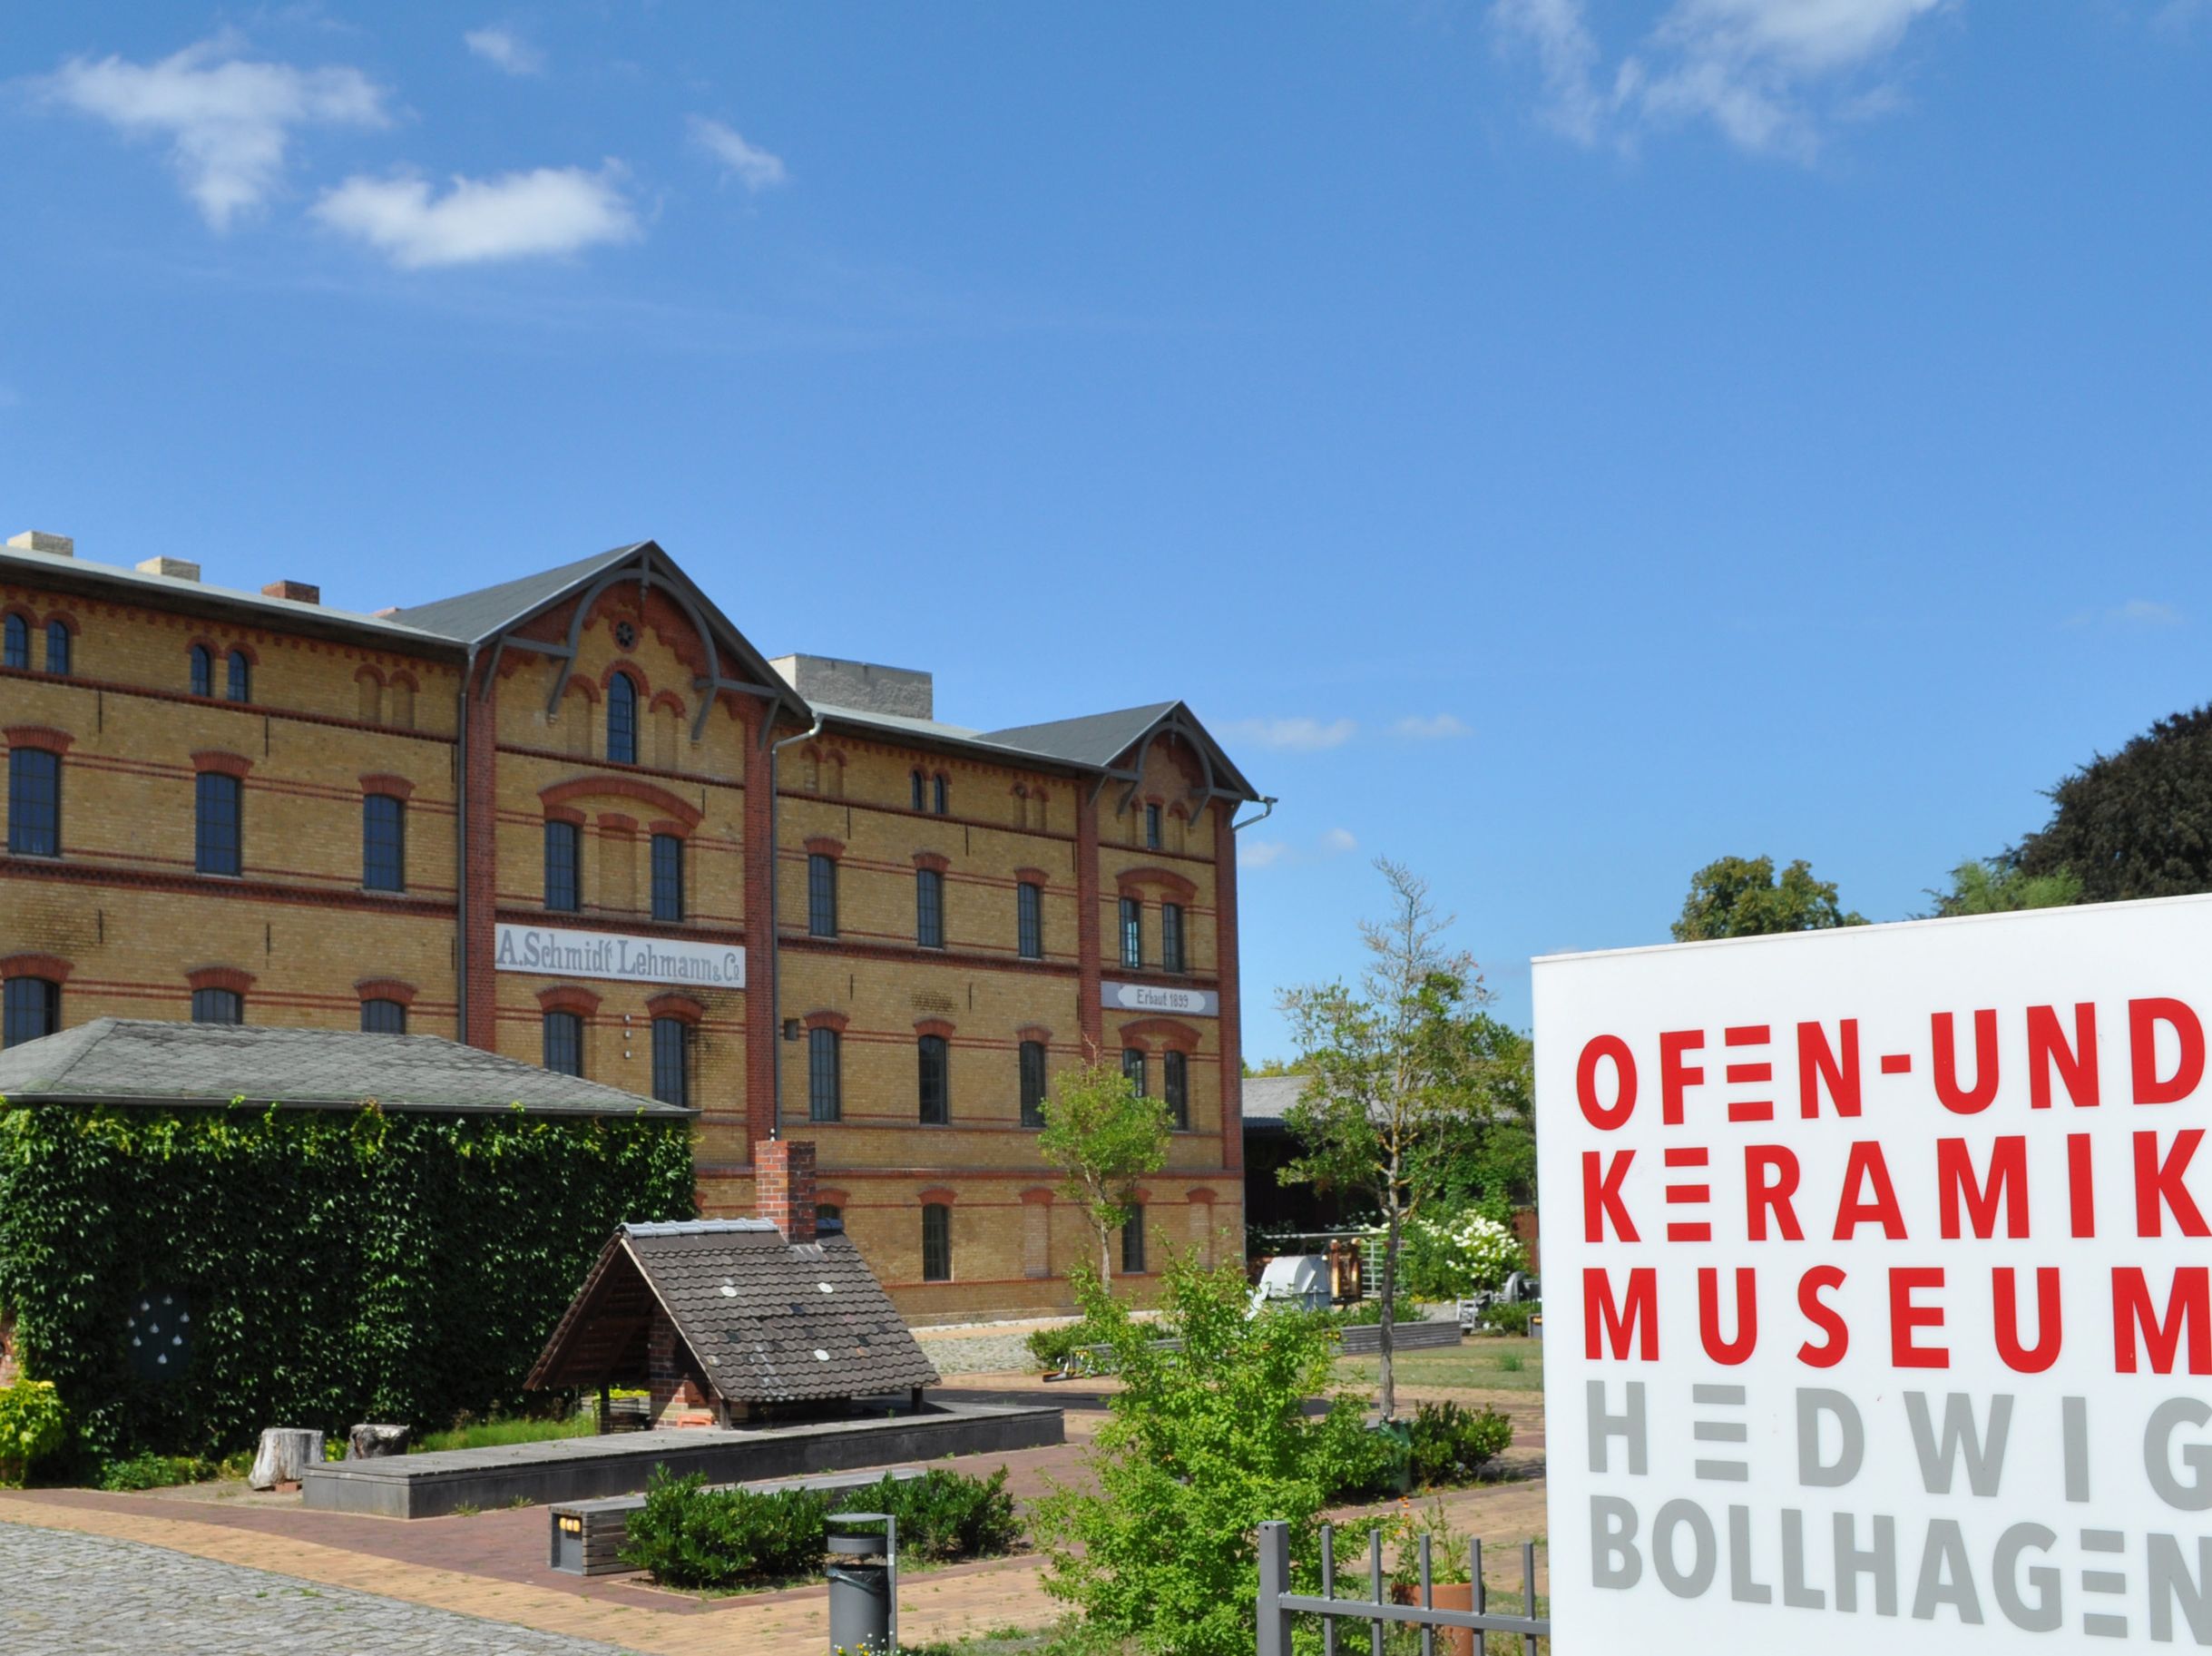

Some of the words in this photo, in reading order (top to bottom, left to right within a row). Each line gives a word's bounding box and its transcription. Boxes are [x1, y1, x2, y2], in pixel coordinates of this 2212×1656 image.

[1136, 988, 1168, 1006] Erbaut
[1169, 993, 1189, 1008] 1899
[1582, 1129, 2212, 1243] KERAMIK
[1583, 1265, 2212, 1375] MUSEUM
[1587, 1380, 2212, 1511] HEDWIG
[1590, 1495, 2212, 1646] BOLLHAGEN
